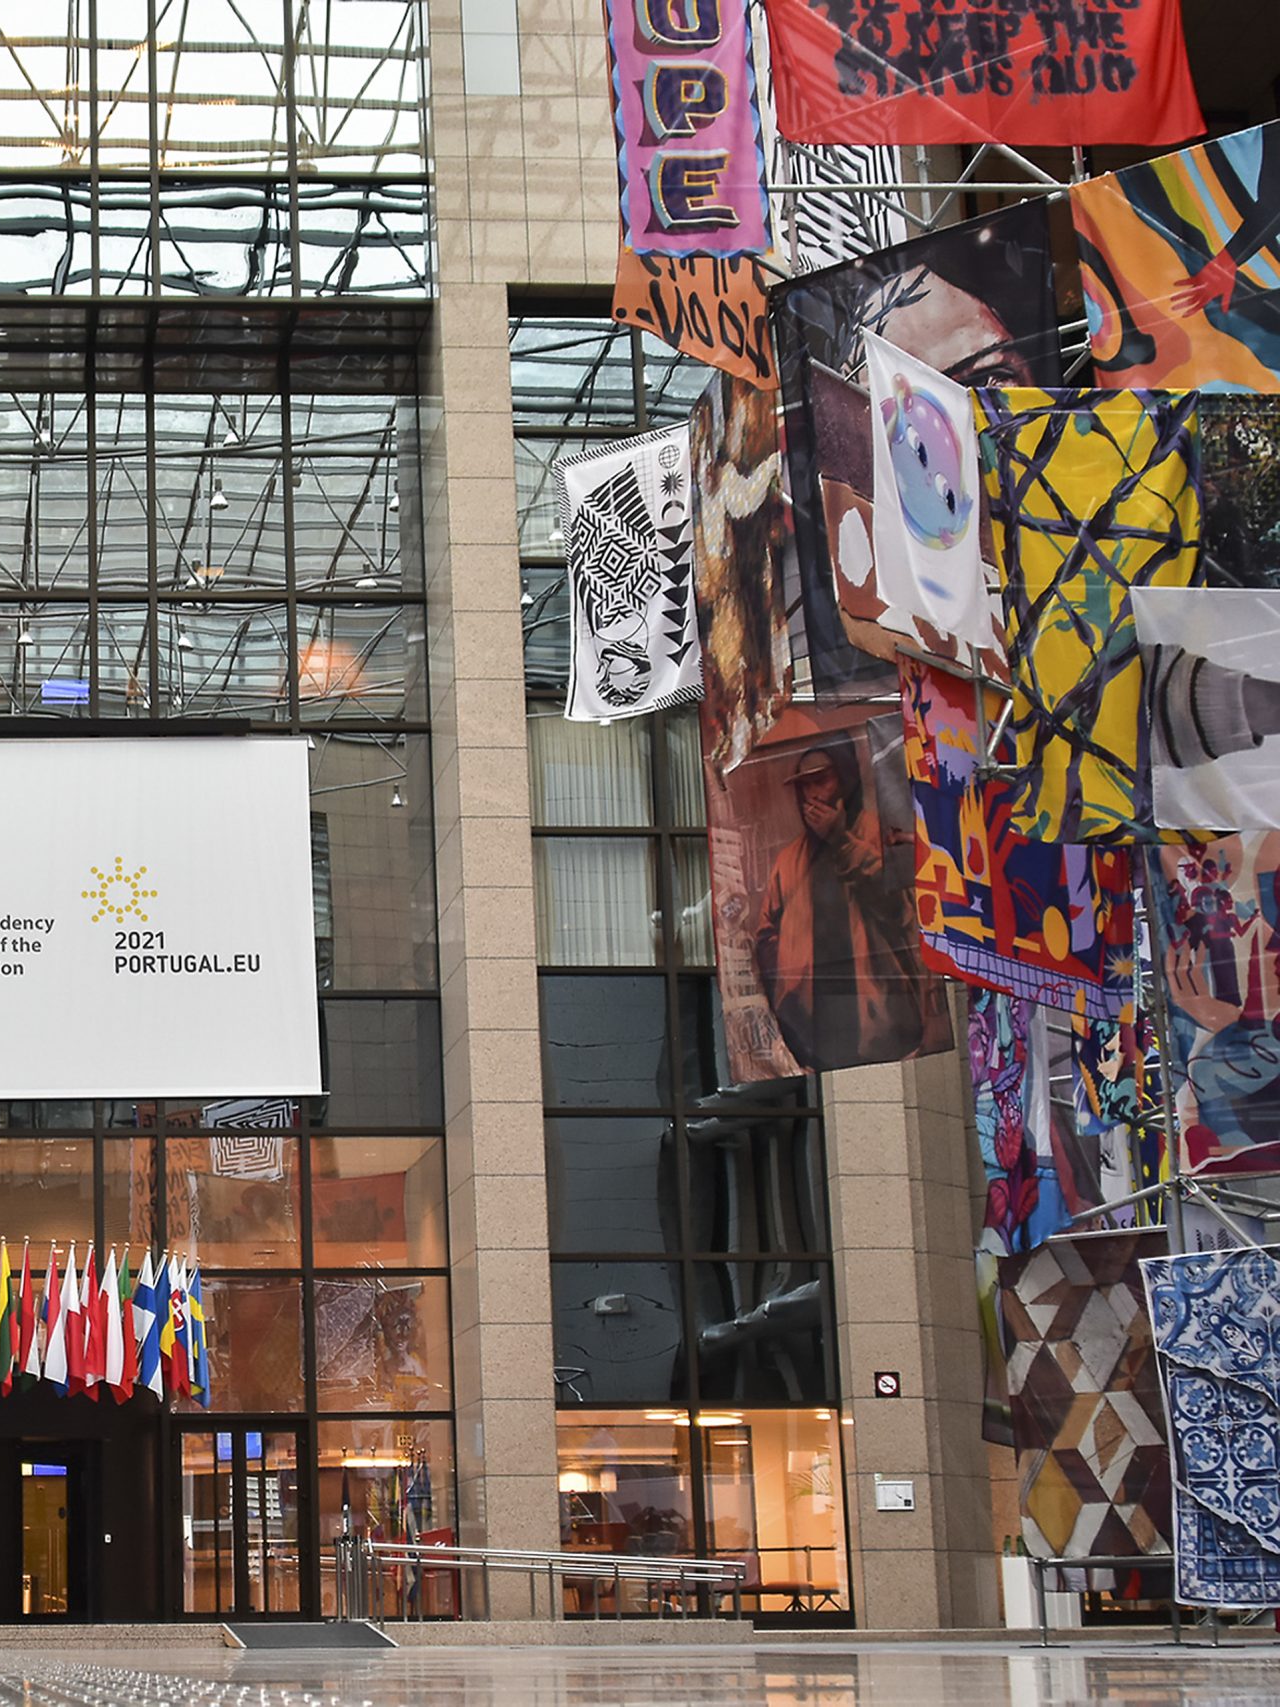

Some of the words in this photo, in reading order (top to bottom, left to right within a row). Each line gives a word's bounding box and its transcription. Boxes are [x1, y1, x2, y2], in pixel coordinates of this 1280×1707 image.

[12, 937, 42, 953] the
[115, 931, 164, 950] 2021
[115, 954, 260, 974] PORTUGAL.EU
